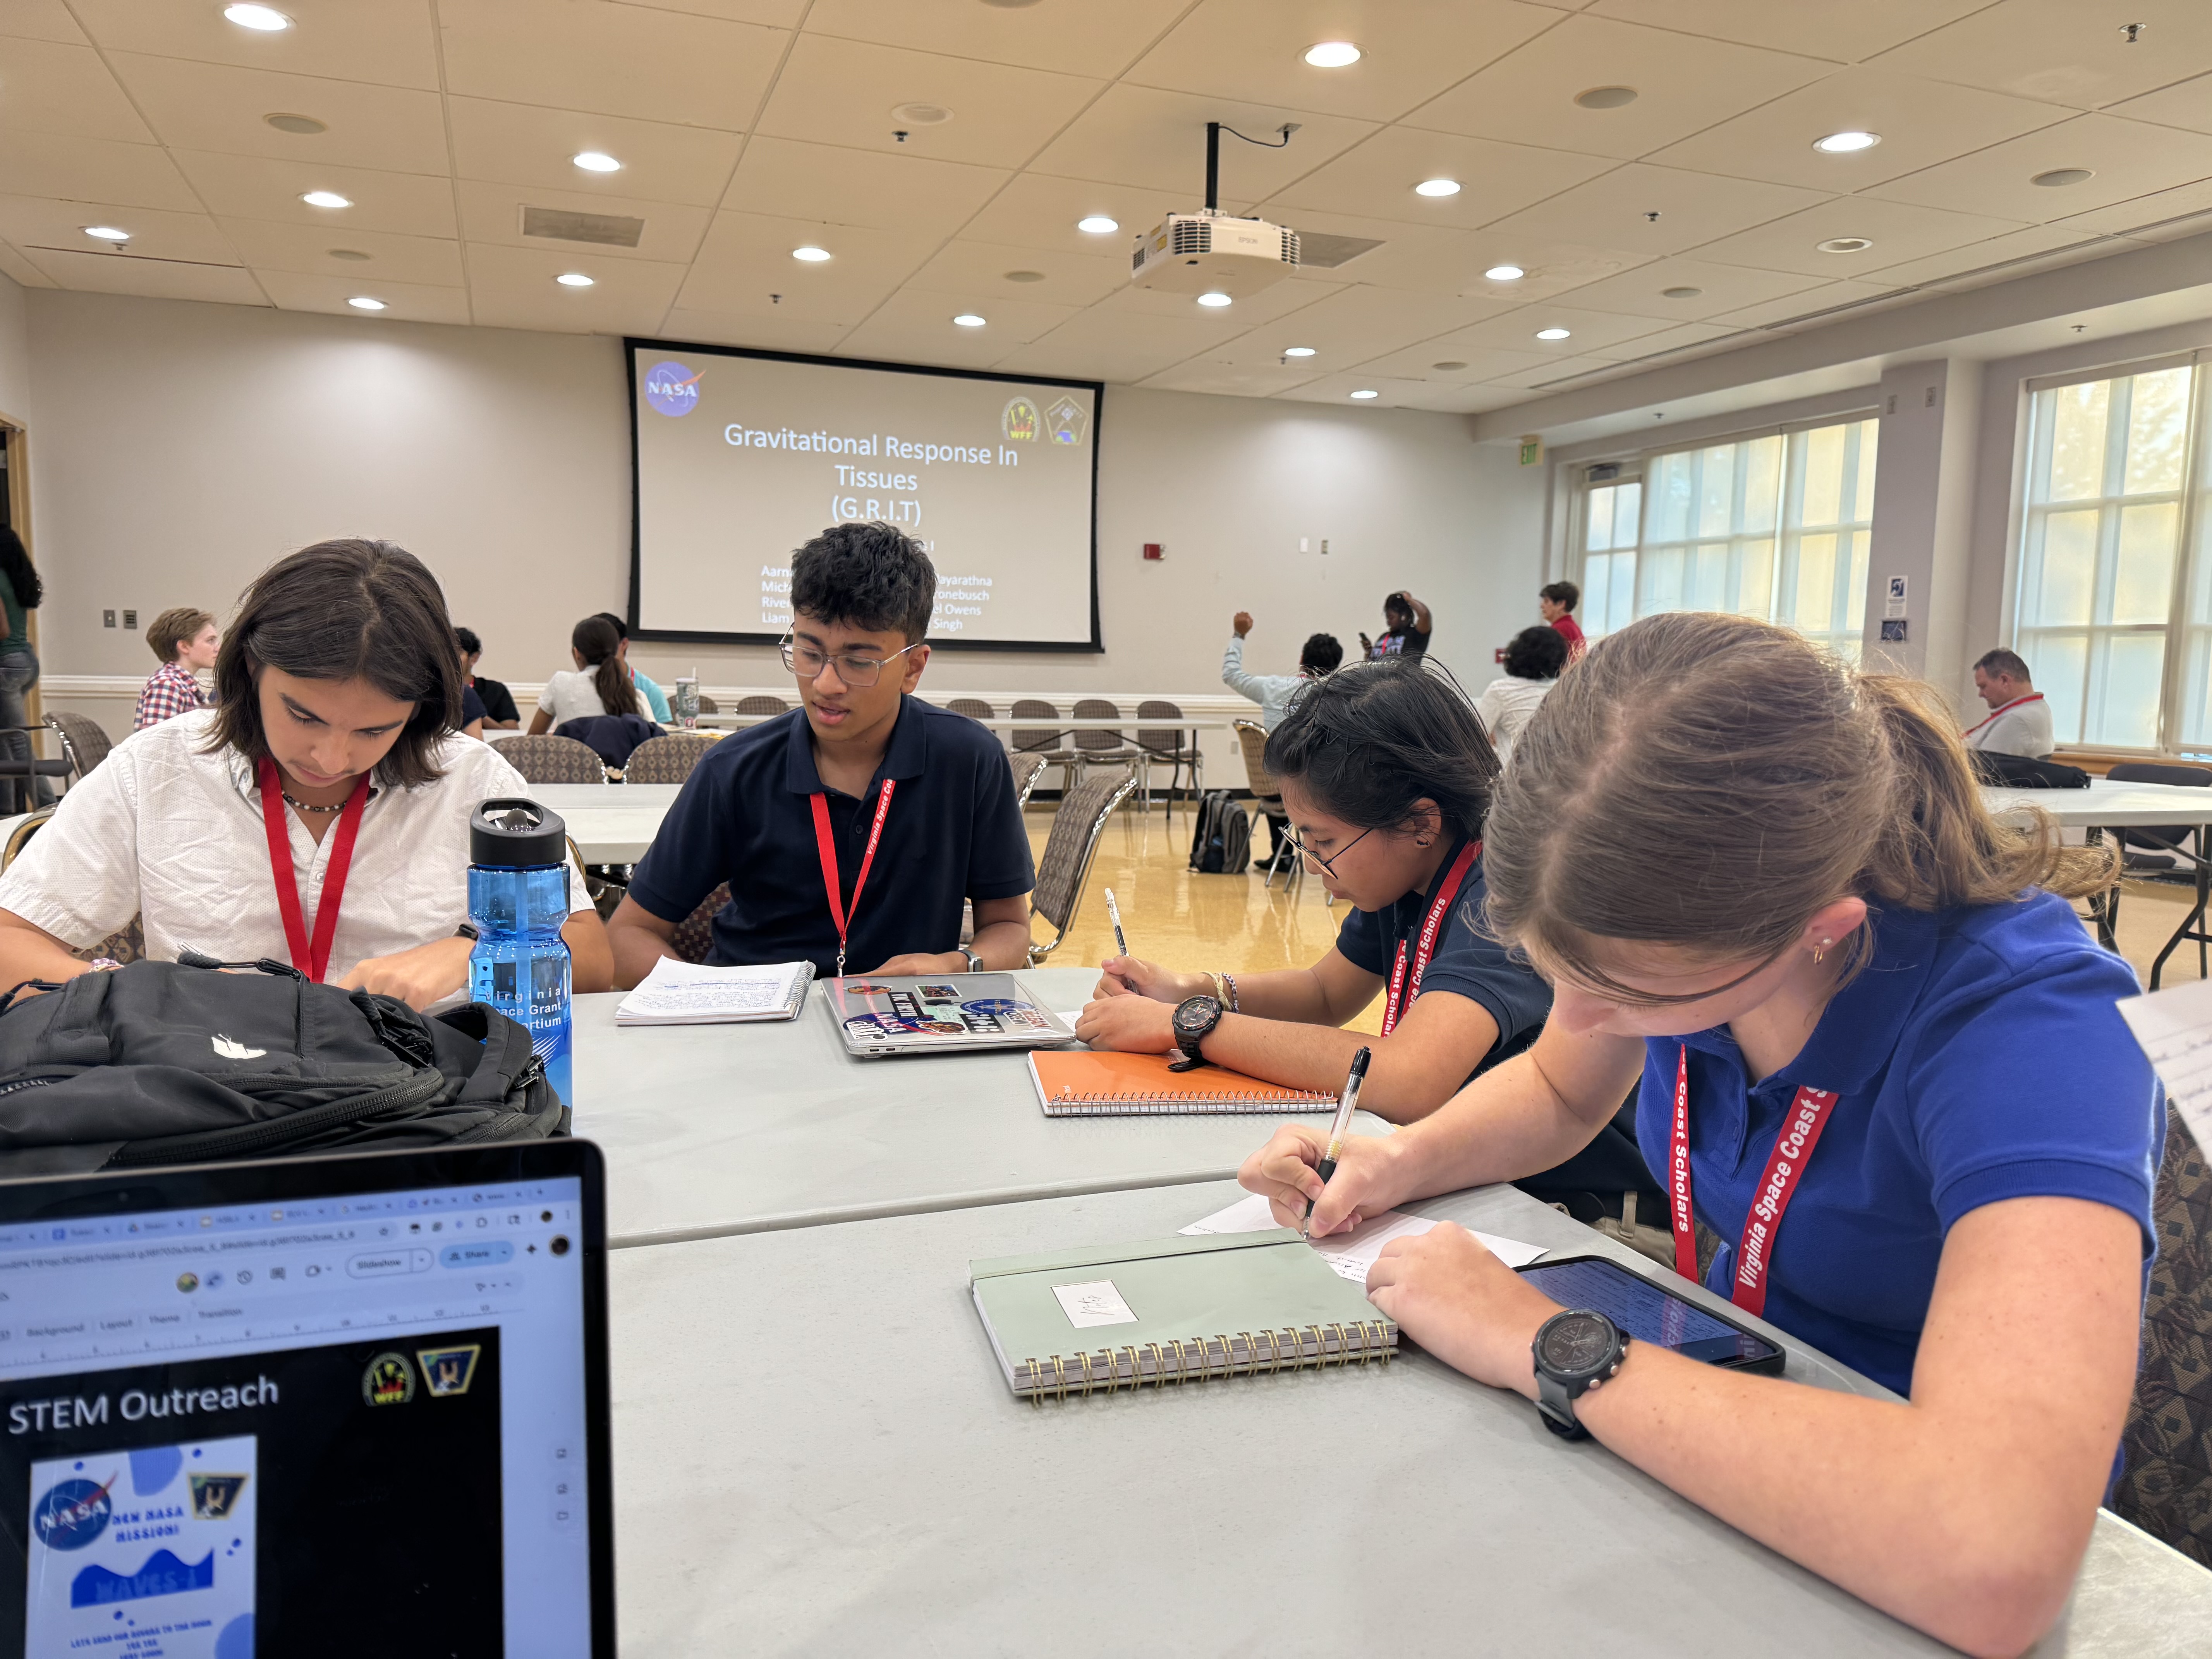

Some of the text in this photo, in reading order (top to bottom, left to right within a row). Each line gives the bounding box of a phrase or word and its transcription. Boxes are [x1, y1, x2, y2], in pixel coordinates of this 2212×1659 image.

[648, 381, 697, 397] NASA
[724, 423, 1018, 466] Gravitational Response In
[1010, 431, 1033, 440] WFF
[834, 465, 918, 491] Tissues
[831, 494, 921, 527] (G.R.I.T)
[762, 611, 790, 624] Liam
[944, 603, 982, 615] Owens
[933, 618, 963, 632] Singh
[867, 779, 893, 855] Virginia Space Coa
[1412, 951, 1427, 986] Coast
[1420, 897, 1446, 951] Scholars
[486, 988, 561, 1003] Virginia
[529, 1001, 561, 1015] Grant
[1384, 955, 1406, 1038] Coast Scholar
[872, 1013, 907, 1033] NASA
[1675, 1081, 1688, 1233] Coast Scholars
[1738, 1223, 1767, 1289] Virginia
[1755, 1162, 1791, 1222] Space
[1780, 1098, 1821, 1159] Coast
[8, 1374, 280, 1434] STEM Outreach
[40, 1499, 109, 1532] NASA
